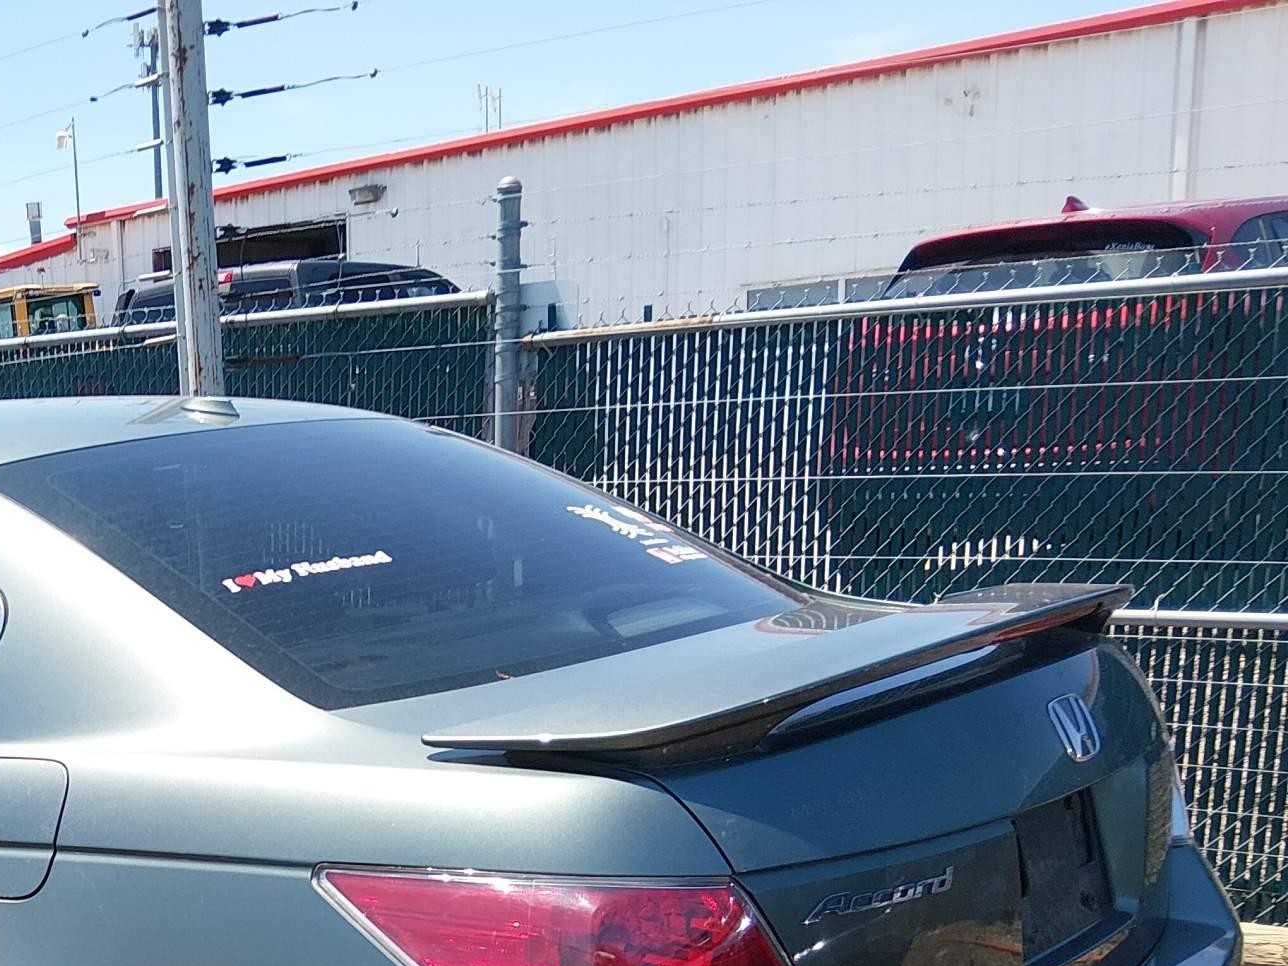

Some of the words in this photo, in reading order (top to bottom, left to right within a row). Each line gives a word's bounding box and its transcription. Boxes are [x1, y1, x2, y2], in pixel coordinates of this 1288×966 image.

[222, 578, 241, 593] I
[253, 569, 292, 585] My
[291, 551, 393, 576] Husband
[800, 866, 954, 925] Accord
